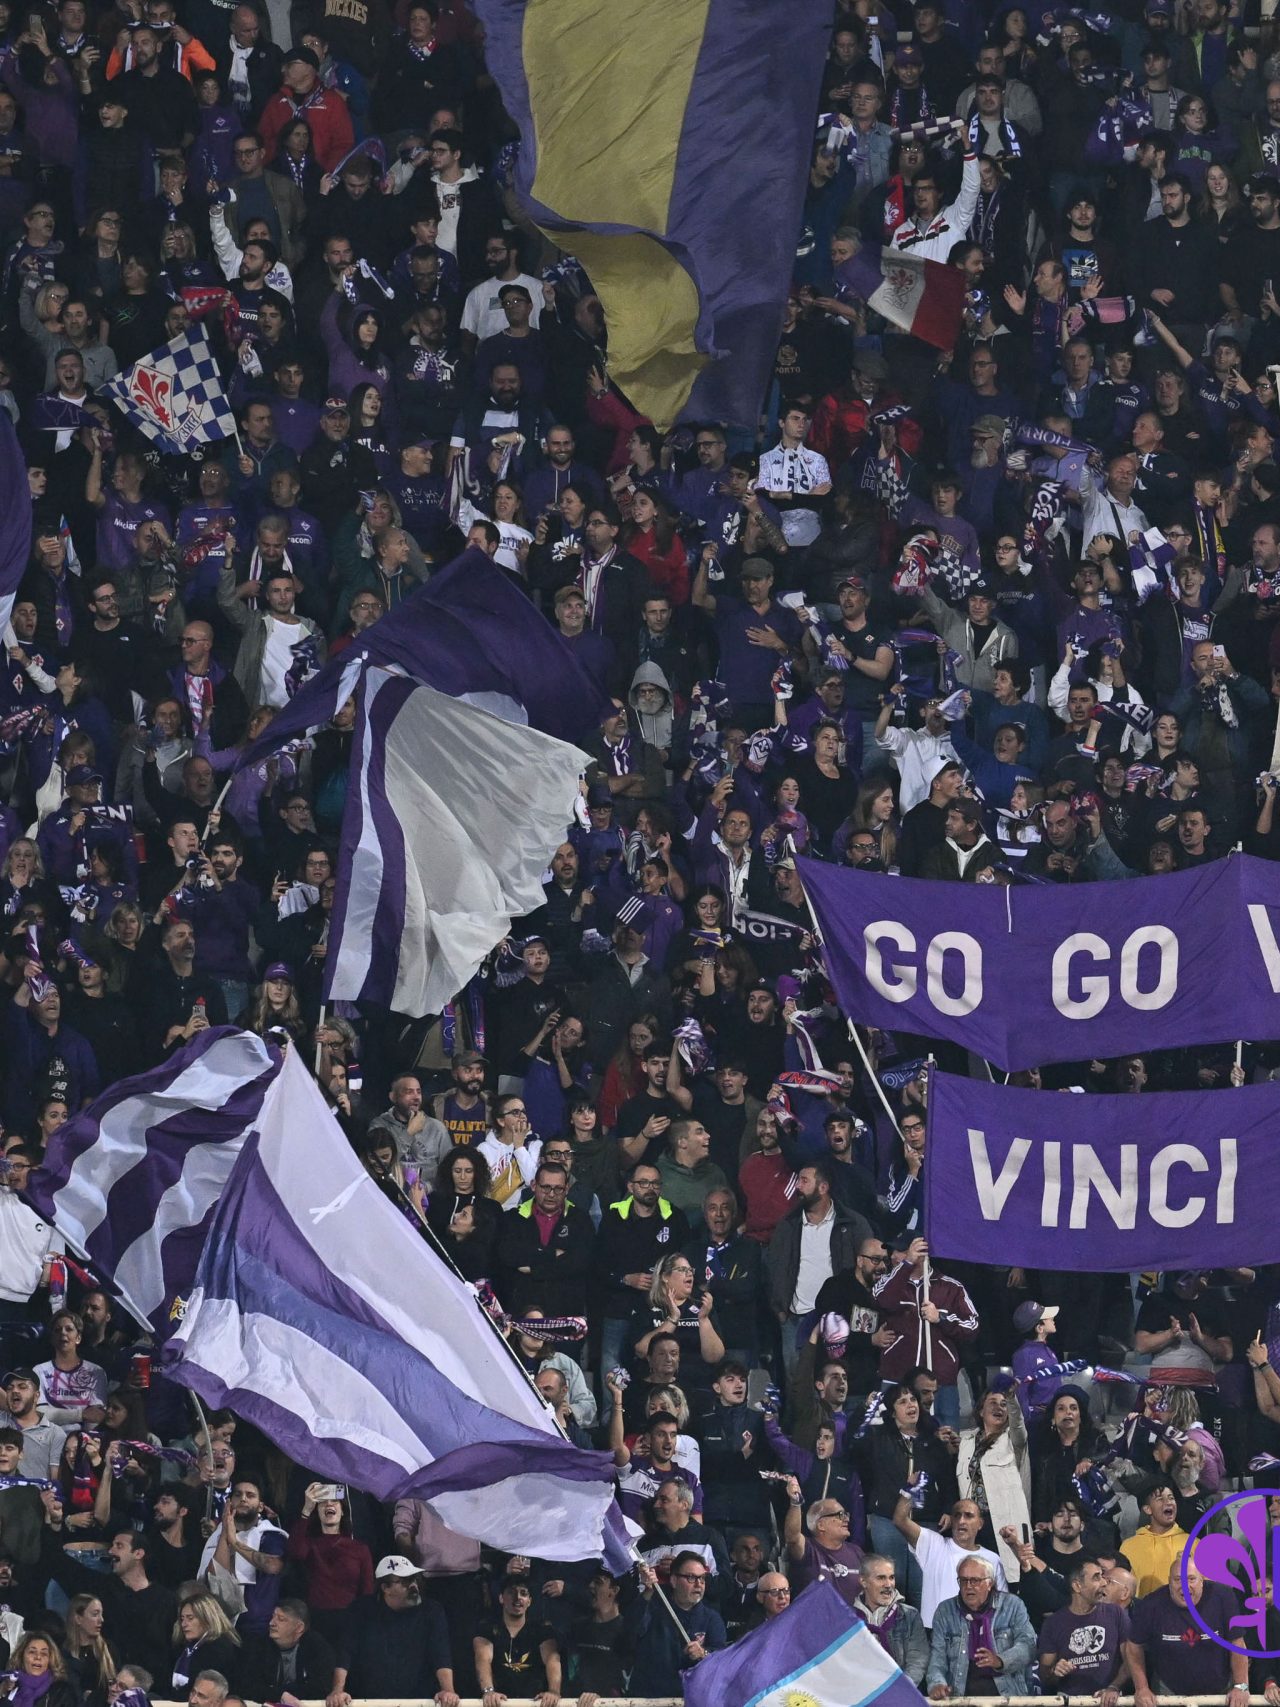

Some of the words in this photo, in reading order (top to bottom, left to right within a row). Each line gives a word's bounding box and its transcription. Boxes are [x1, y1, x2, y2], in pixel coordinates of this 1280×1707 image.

[864, 921, 983, 1017] GO
[1051, 925, 1179, 1020] GO
[968, 1129, 1238, 1230] VINCI
